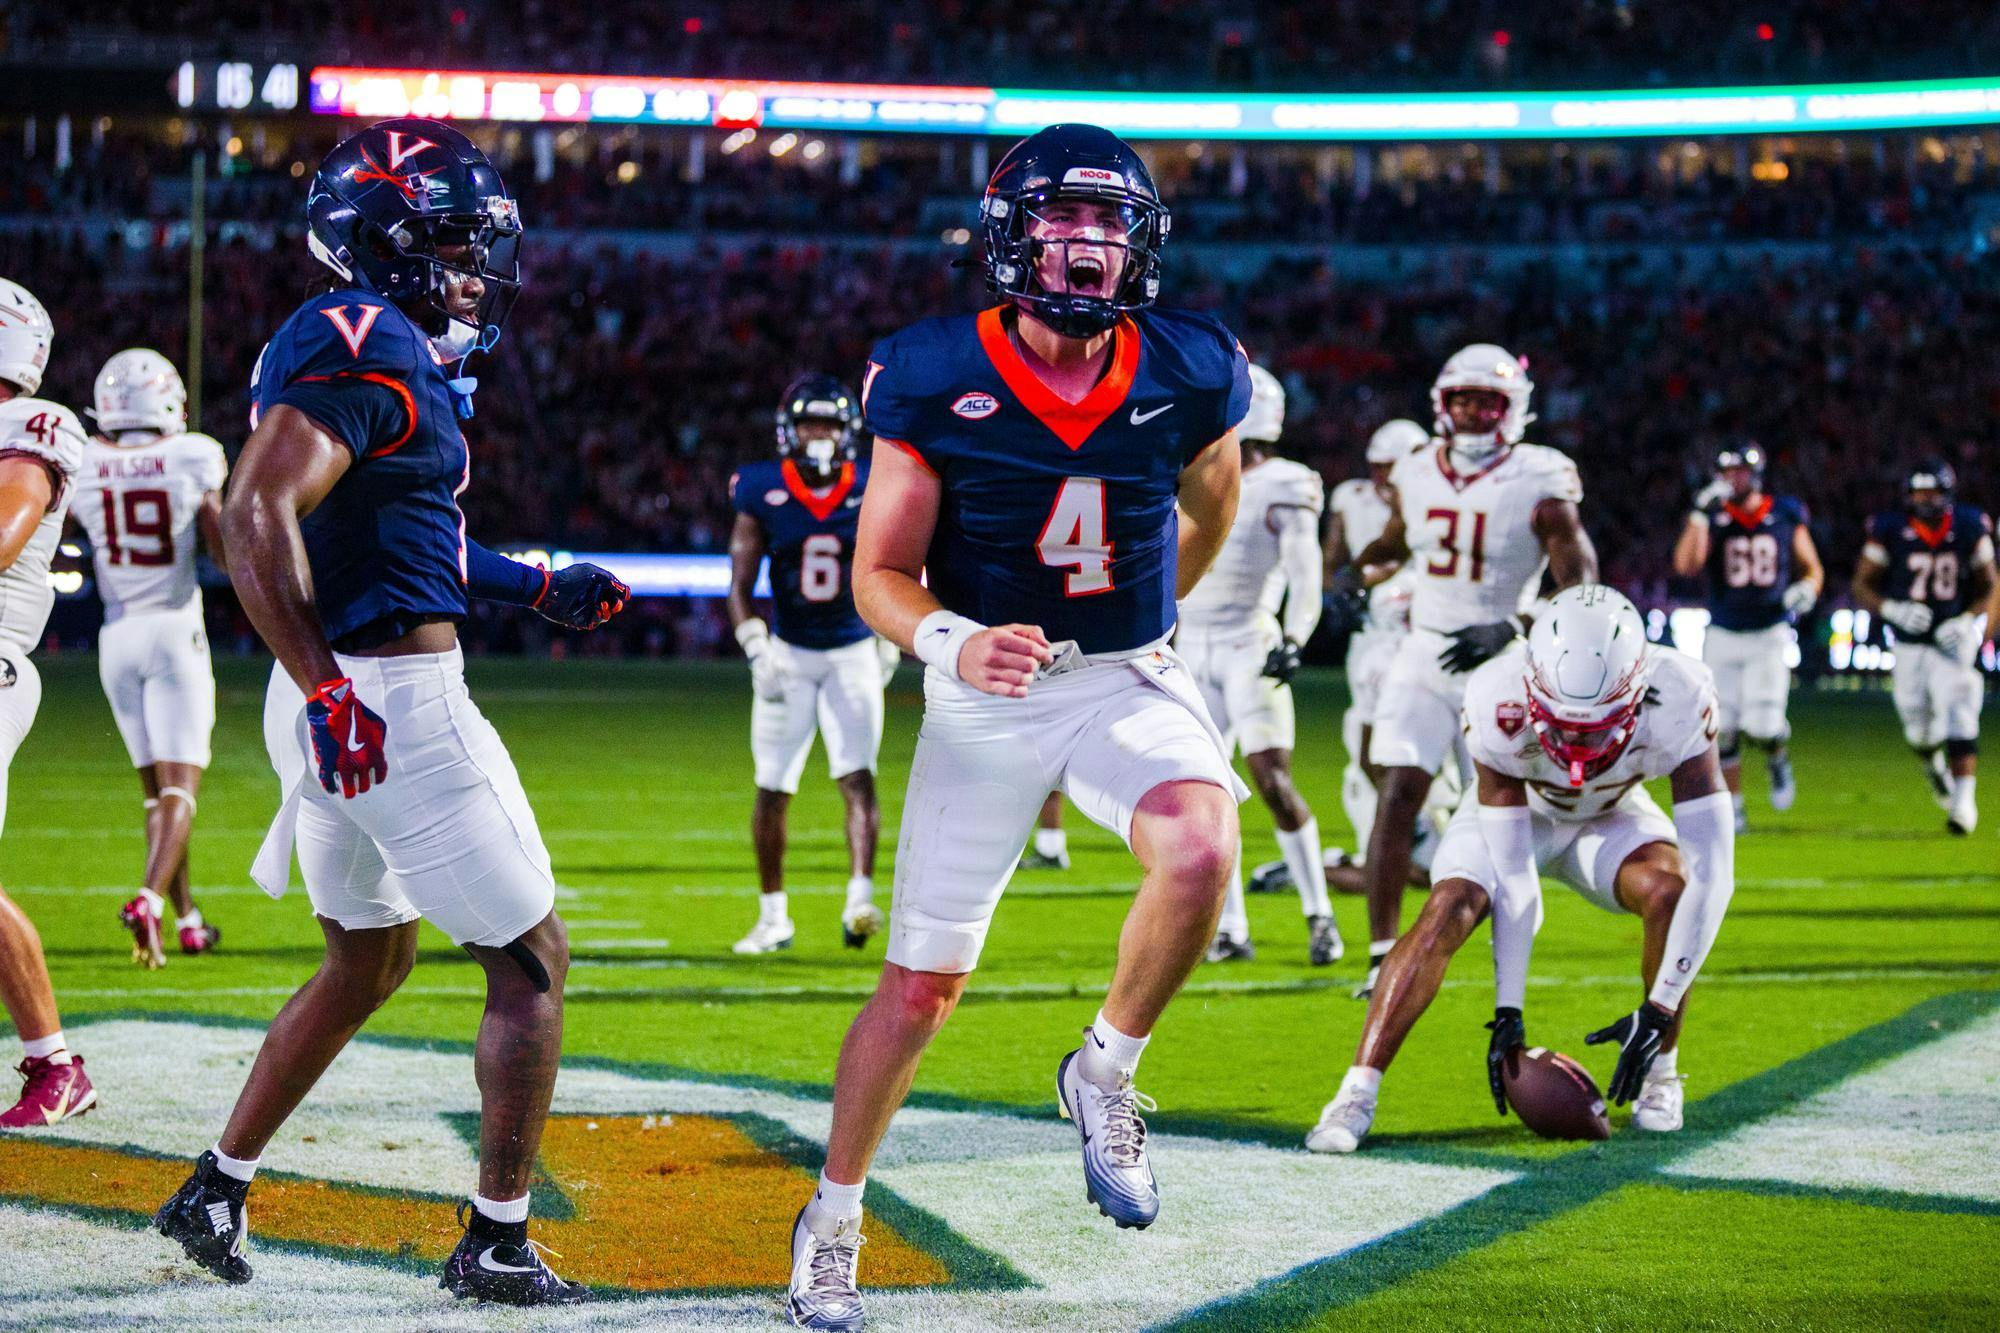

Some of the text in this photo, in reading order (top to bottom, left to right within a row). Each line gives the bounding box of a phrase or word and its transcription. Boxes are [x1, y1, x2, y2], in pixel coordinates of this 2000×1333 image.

[1080, 170, 1111, 180] HOOS
[319, 303, 384, 360] V
[957, 399, 992, 412] ACC
[94, 455, 167, 478] WILSON
[102, 489, 176, 567] 19
[1034, 475, 1117, 598] 4
[1426, 507, 1487, 582] 31
[801, 534, 842, 602] 6
[205, 1201, 233, 1237] NIKE
